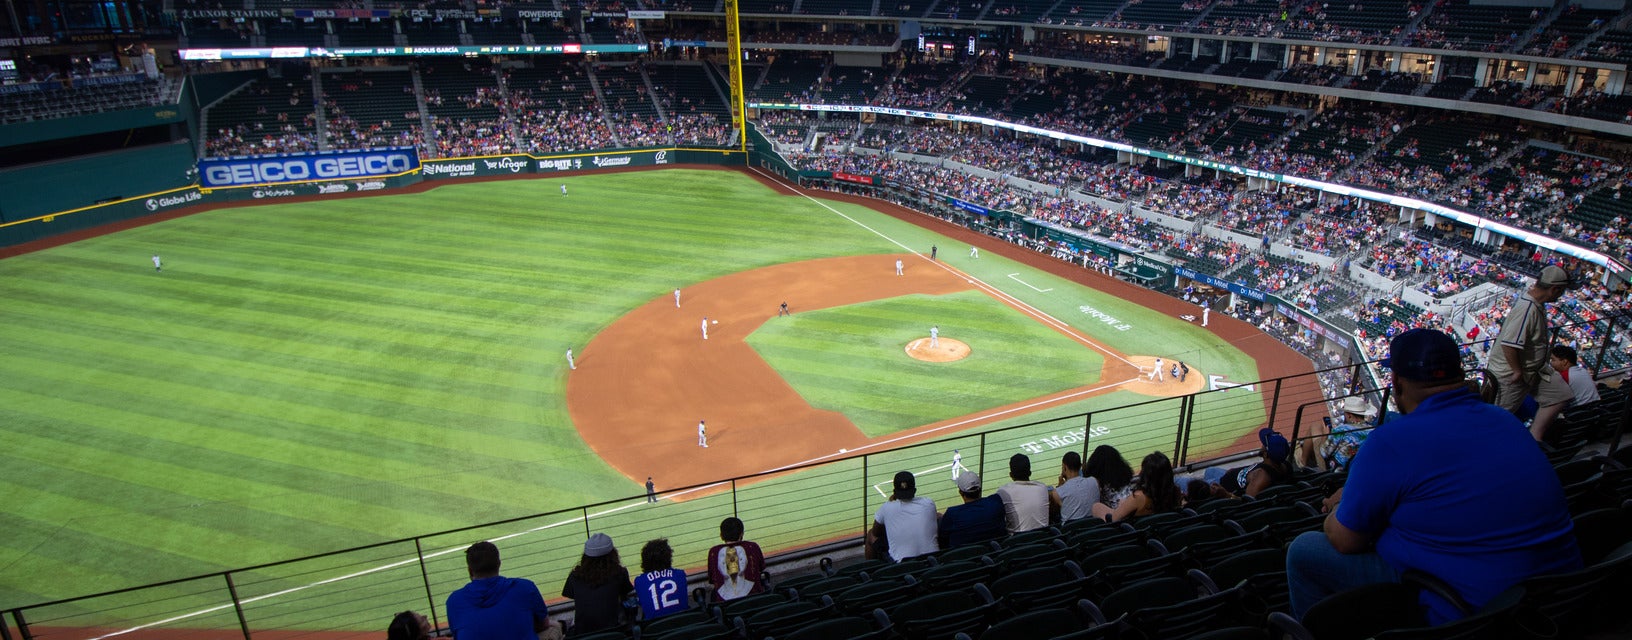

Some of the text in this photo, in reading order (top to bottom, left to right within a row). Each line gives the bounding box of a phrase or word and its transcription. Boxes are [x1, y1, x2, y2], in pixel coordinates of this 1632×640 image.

[193, 9, 278, 18] LUXOR STAFFING
[518, 10, 563, 18] POWERADE
[435, 163, 475, 173] National
[498, 157, 528, 172] Kroger
[539, 160, 554, 168] BIG
[554, 159, 572, 168] BITE
[206, 154, 410, 185] GEICO GEICO
[159, 191, 202, 207] Globe Life
[1182, 268, 1196, 278] Mitel
[1213, 278, 1228, 289] Mitel
[1247, 289, 1263, 301] Mitel
[648, 580, 680, 610] 12
